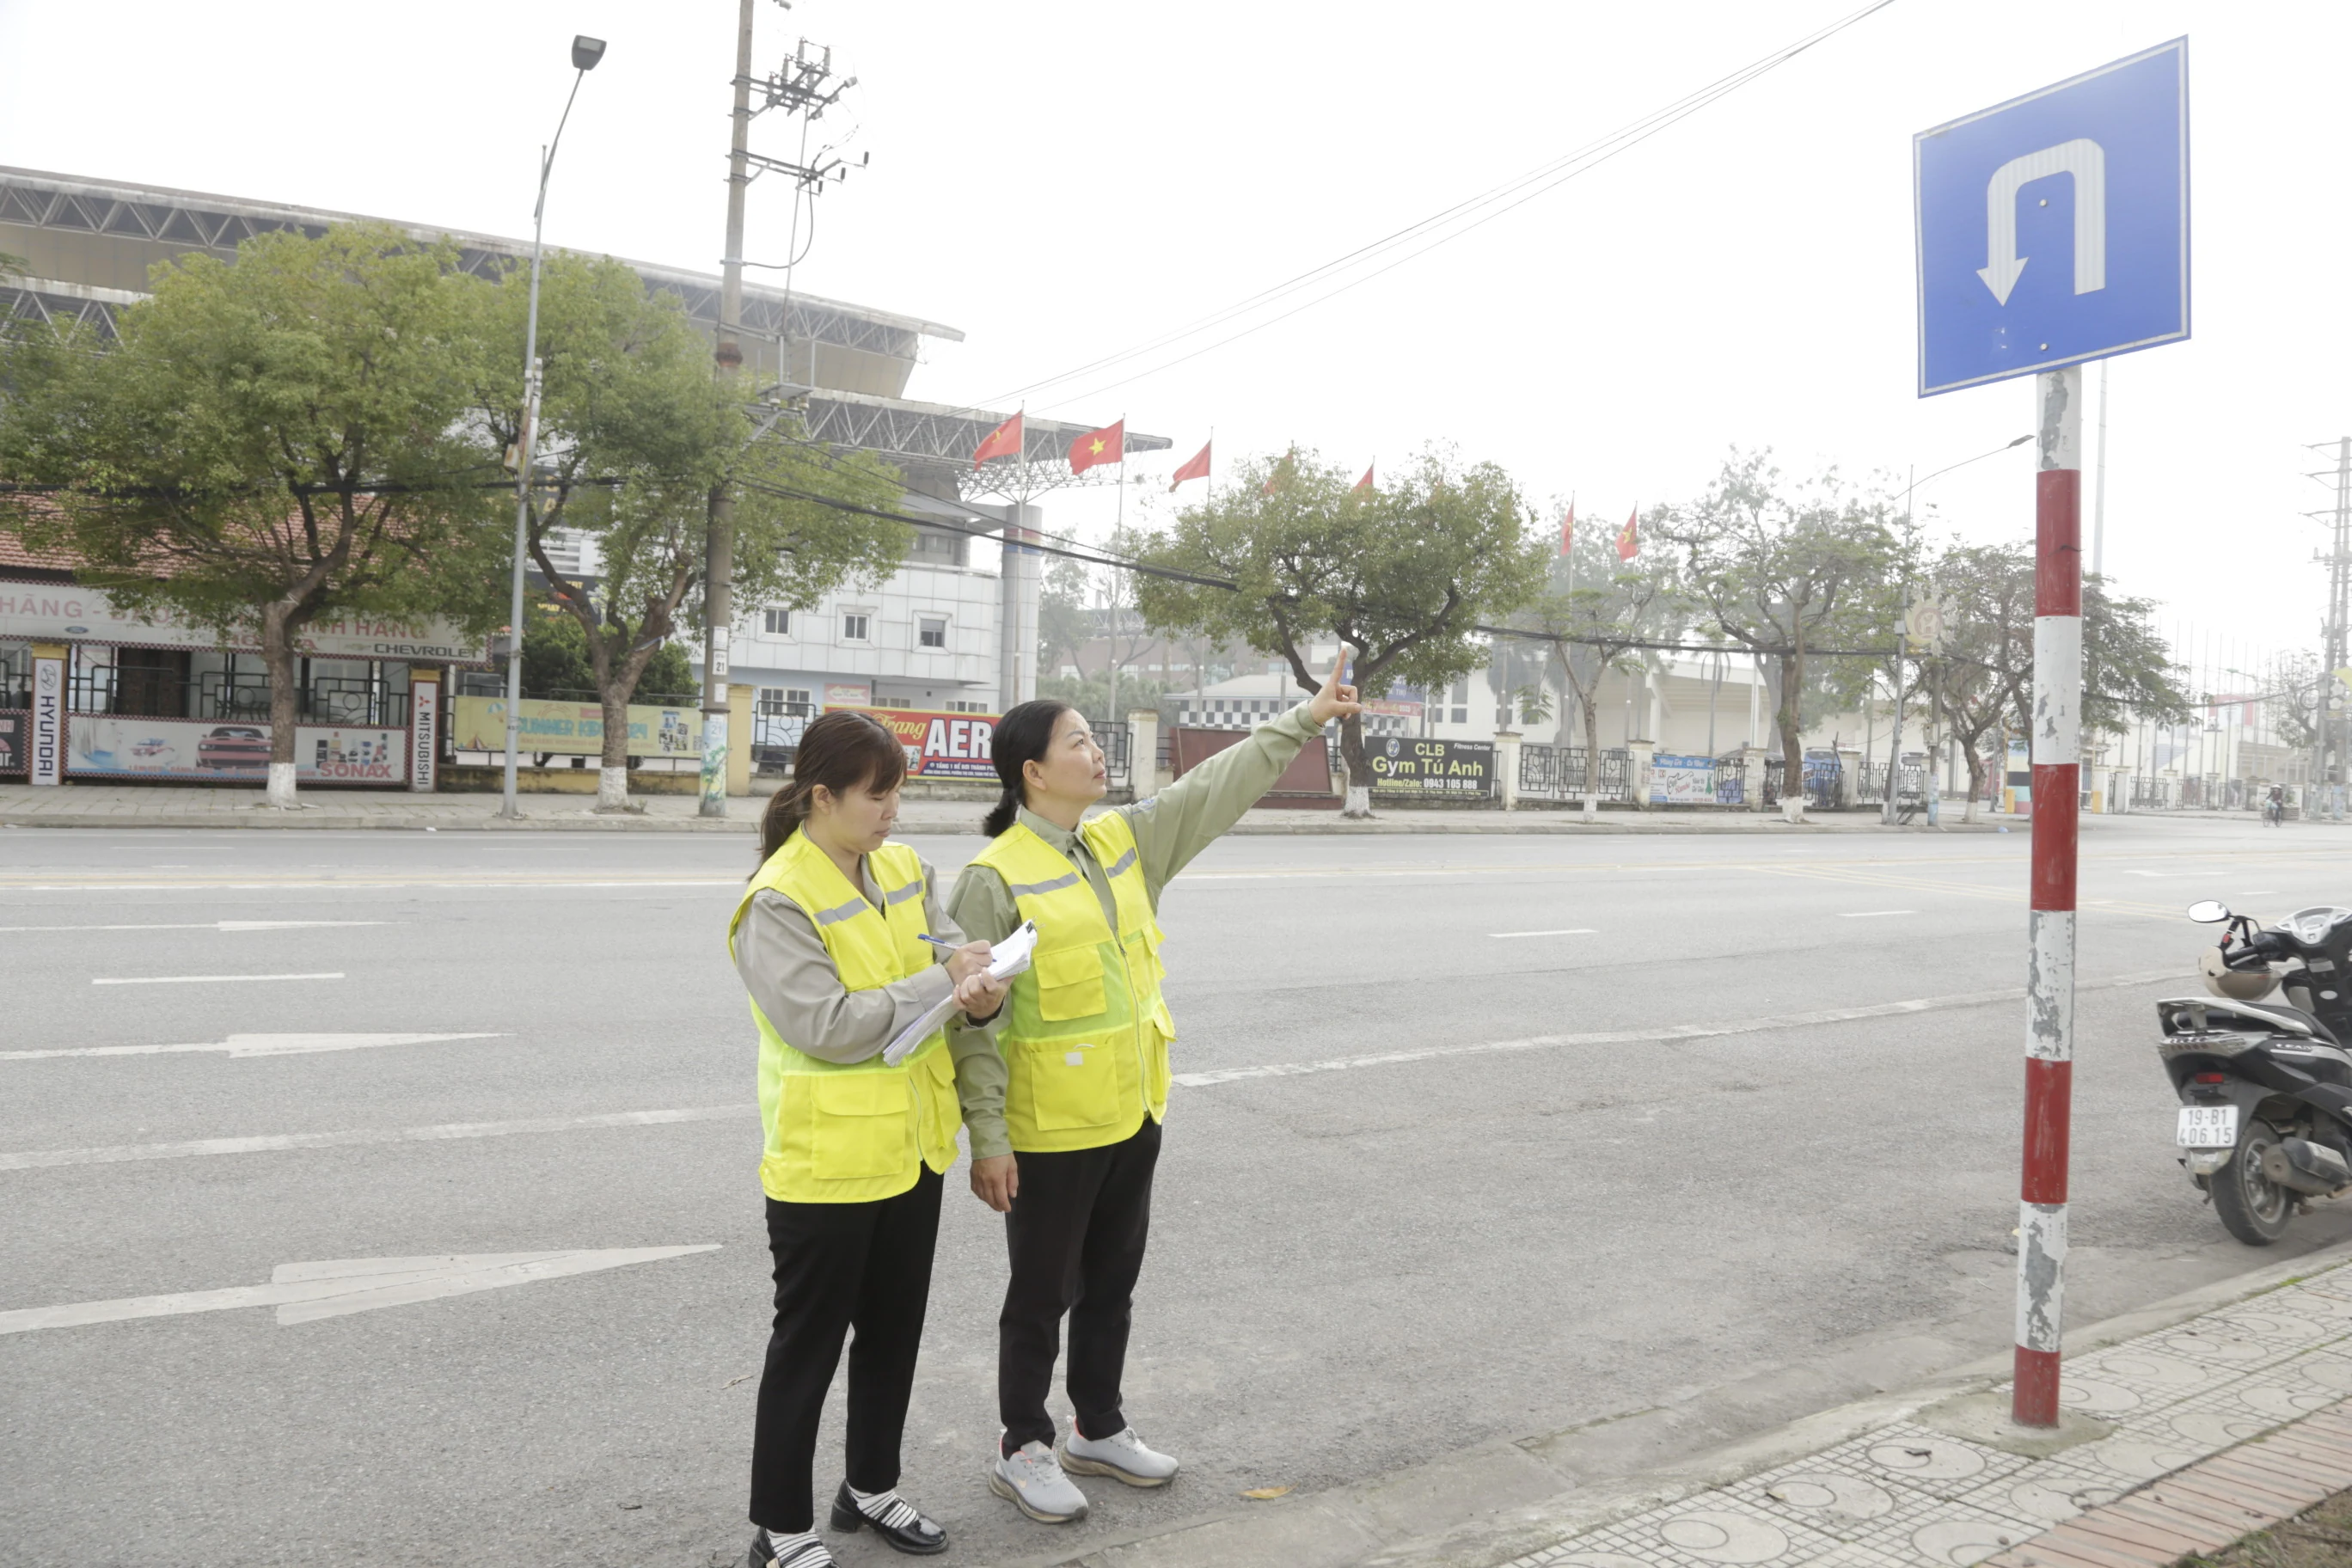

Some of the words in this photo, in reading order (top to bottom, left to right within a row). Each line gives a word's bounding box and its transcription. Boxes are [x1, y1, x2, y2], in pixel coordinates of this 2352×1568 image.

[374, 643, 479, 658] CHEVROLET
[716, 661, 726, 672] 21
[39, 695, 55, 776] HYUNDAI
[924, 719, 991, 759] AER
[417, 712, 432, 785] MITSUBISHI
[1415, 742, 1445, 756] CLB
[1454, 742, 1473, 750] Fitness
[320, 763, 393, 779] SONAX
[1372, 756, 1416, 777] Gym
[1421, 758, 1443, 775] Tú
[1448, 760, 1483, 776] Anh
[1377, 778, 1423, 789] Hotline/Zalo:
[1424, 777, 1444, 789] 0943
[1446, 779, 1461, 789] 105
[1462, 780, 1478, 790] 888
[2188, 1109, 2227, 1126] 19-B1
